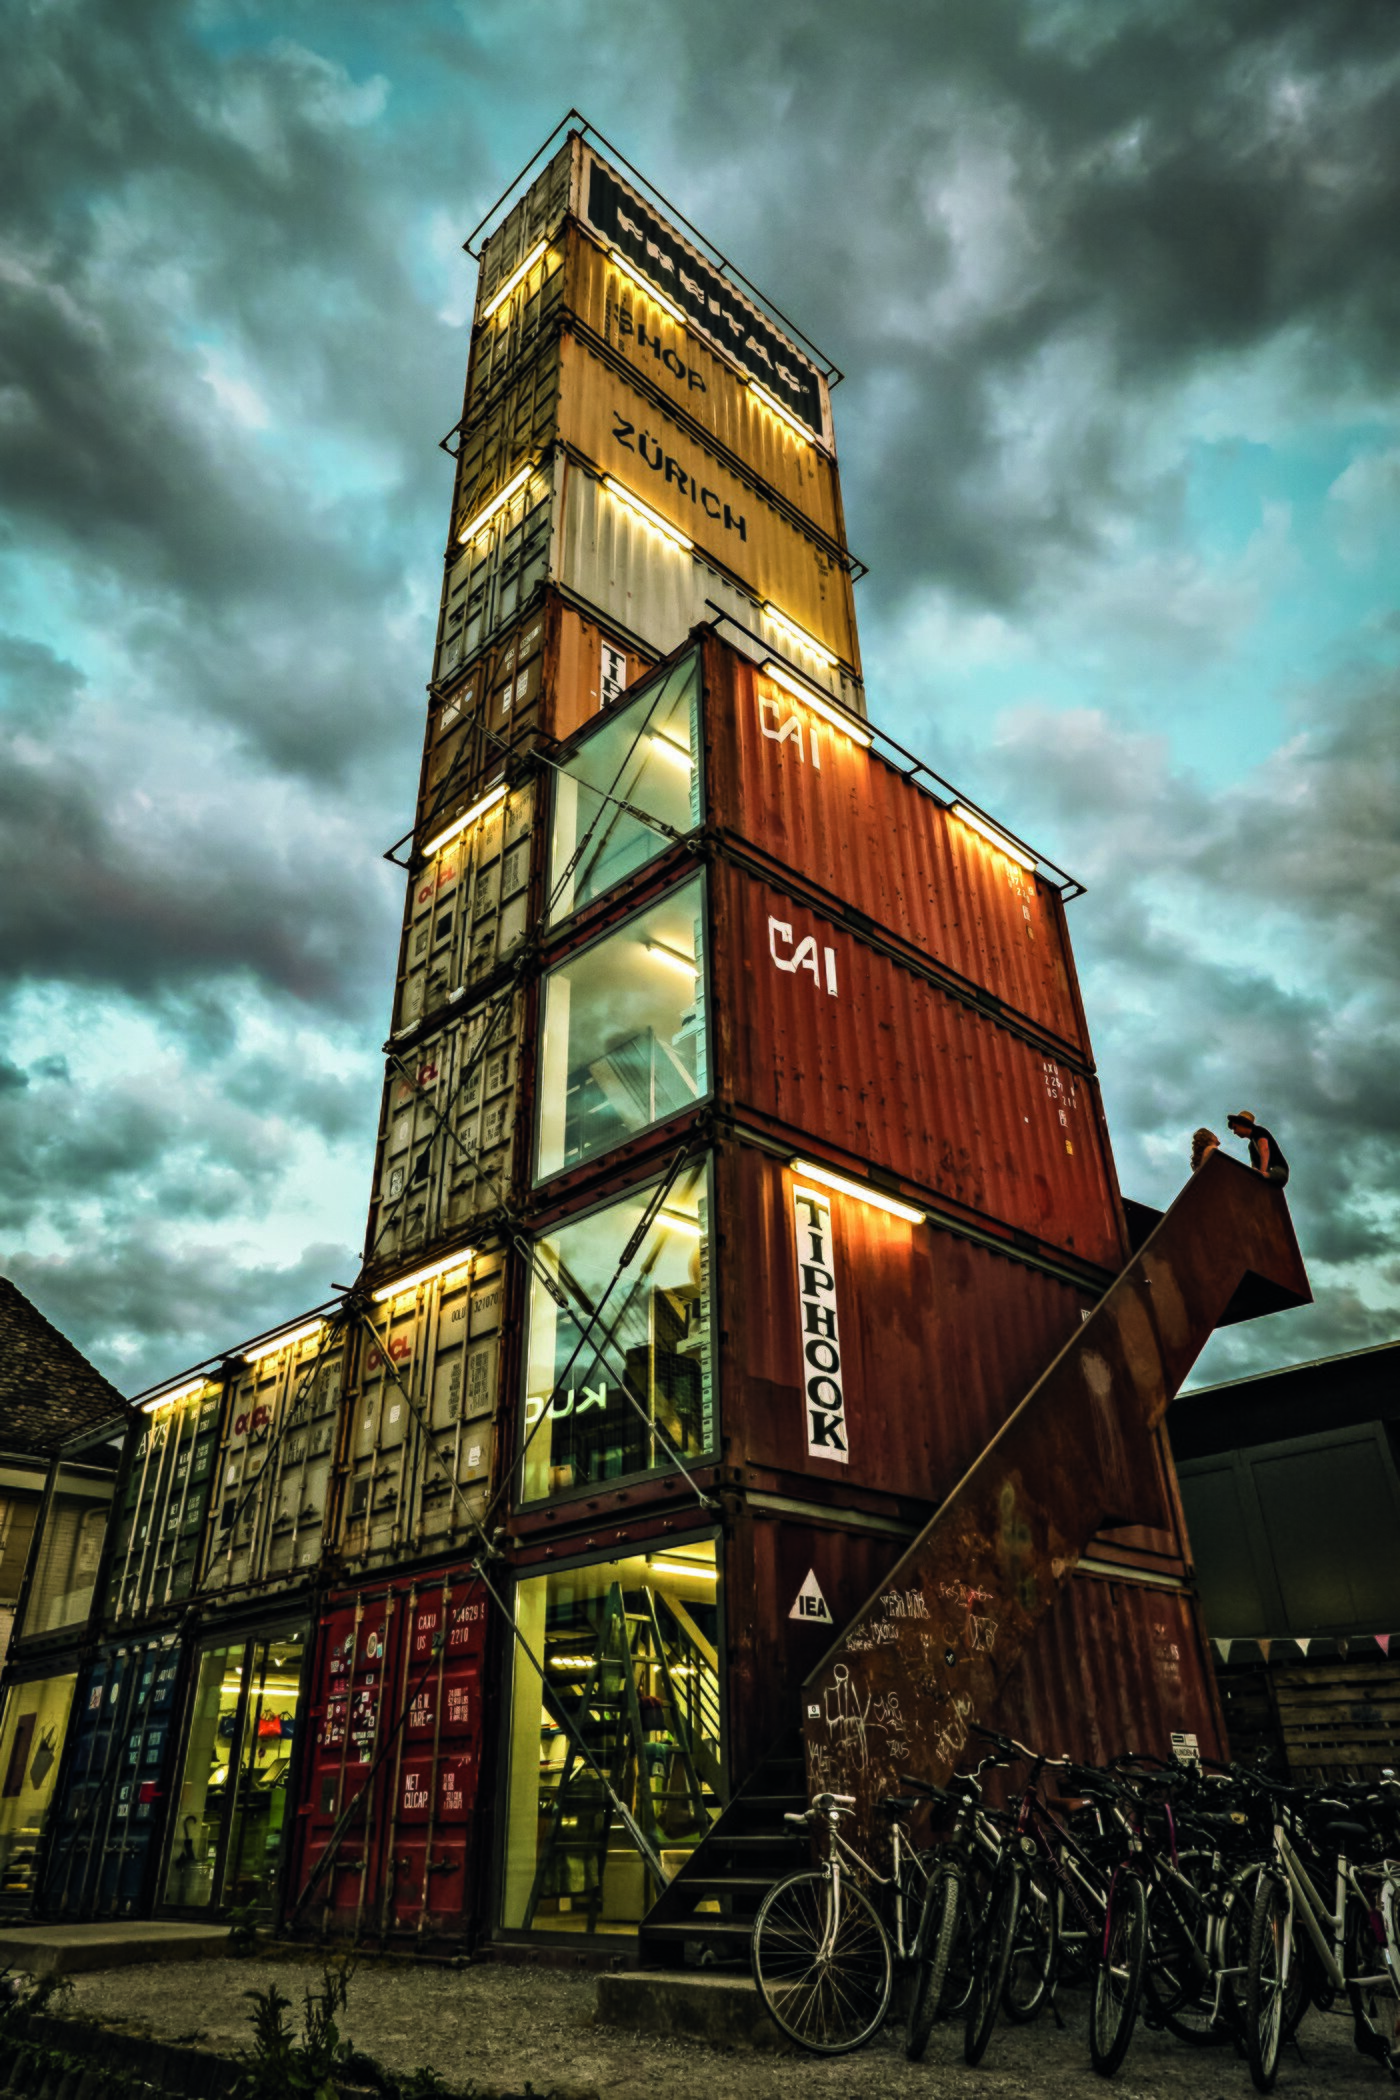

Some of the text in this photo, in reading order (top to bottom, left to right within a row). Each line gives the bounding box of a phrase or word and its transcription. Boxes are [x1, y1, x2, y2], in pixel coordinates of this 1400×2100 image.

[614, 303, 707, 393] SHOP
[612, 410, 748, 543] ZÜRICH
[758, 694, 821, 769] CAI
[767, 915, 839, 997] CAI
[795, 1194, 848, 1451] TIPHOOK
[418, 1613, 437, 1631] CAXU
[799, 1595, 828, 1619] IEA
[410, 1710, 427, 1728] TARE
[405, 1773, 420, 1791] NET
